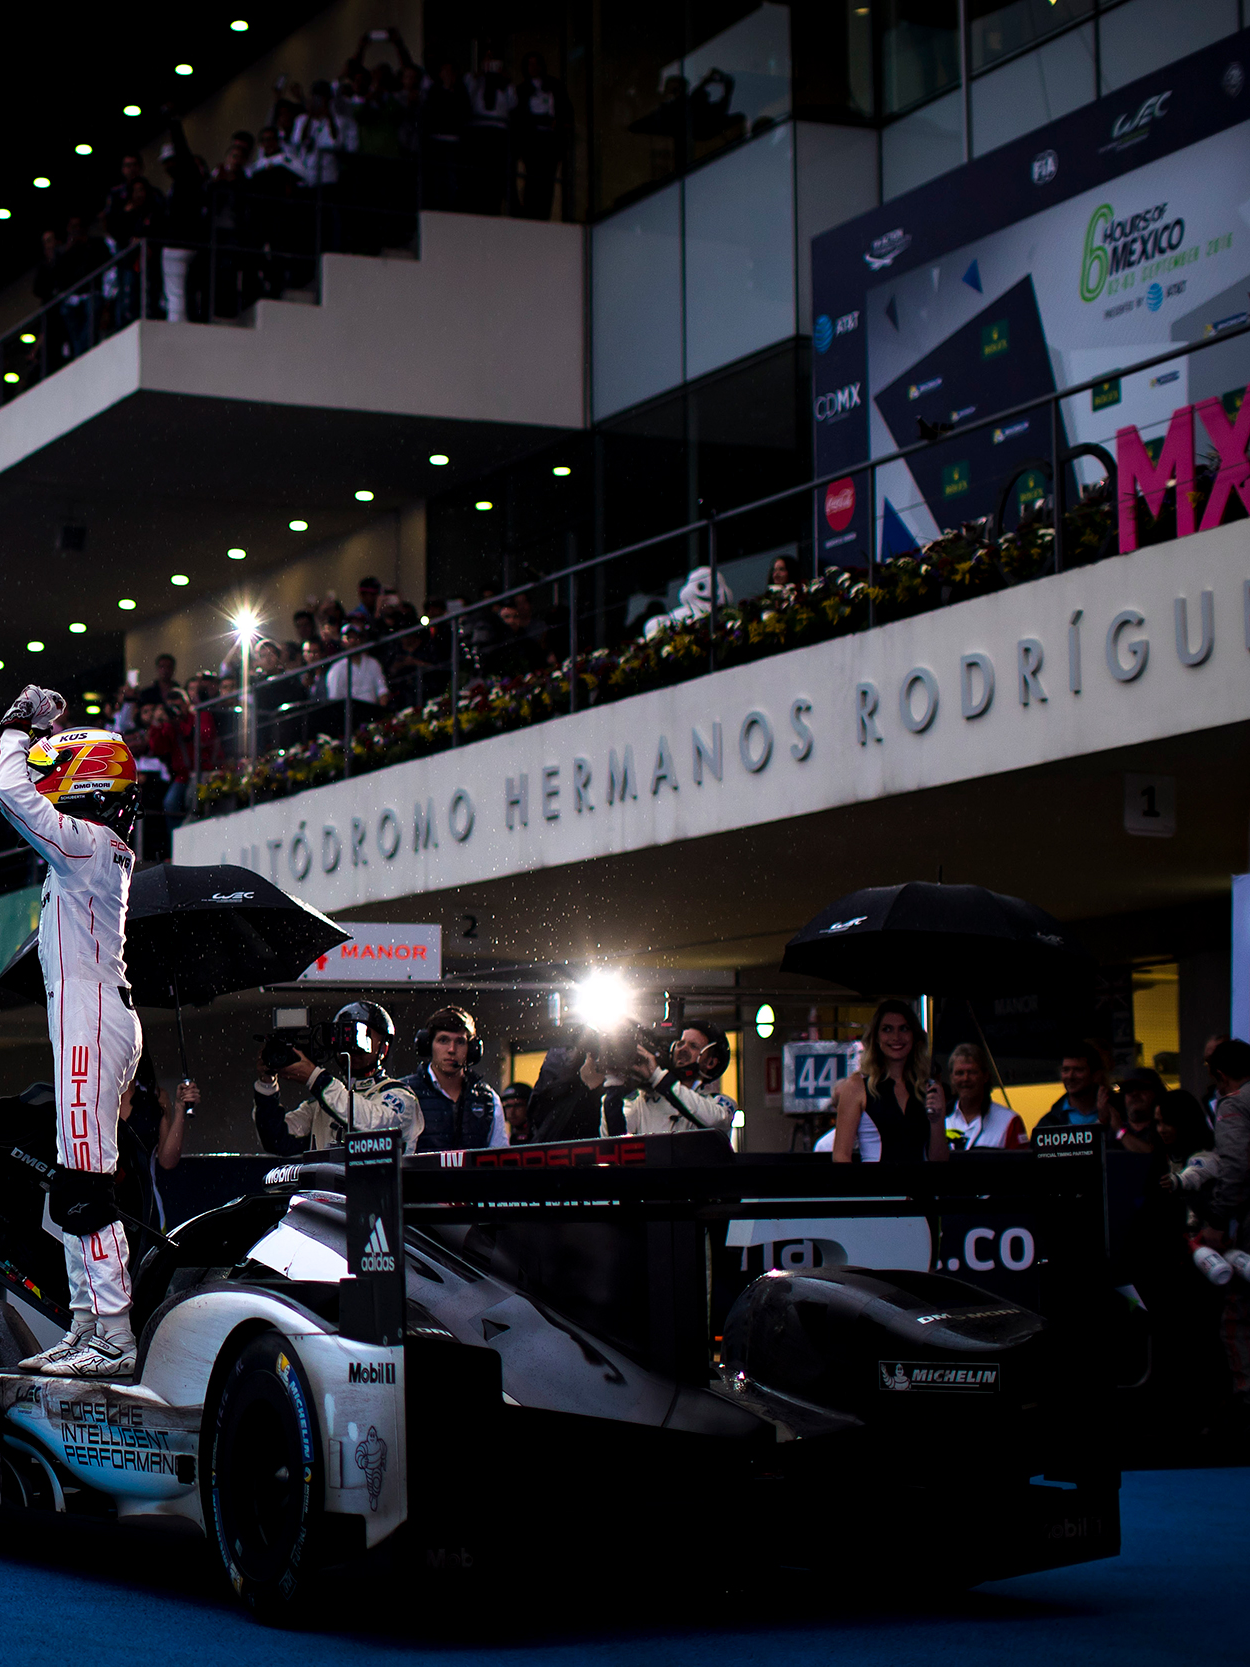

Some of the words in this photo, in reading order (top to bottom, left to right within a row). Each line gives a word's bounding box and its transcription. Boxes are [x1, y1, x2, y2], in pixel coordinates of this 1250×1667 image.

[1102, 206, 1155, 245] HOURS
[1078, 203, 1114, 303] 6
[1109, 217, 1185, 277] MEXICO
[835, 310, 860, 336] AT&T
[813, 381, 862, 422] CDMX
[505, 698, 813, 830] HERMANOS
[856, 580, 1250, 746] RODRÍGU
[1140, 785, 1161, 818] 1
[212, 891, 255, 900] WEC
[462, 915, 478, 938] 2
[341, 944, 428, 961] MANOR
[798, 1056, 838, 1096] 44
[348, 1137, 393, 1154] CHOPARD
[1036, 1131, 1094, 1147] CHOPARD
[9, 1147, 49, 1173] DMG
[361, 1252, 396, 1272] adidas
[349, 1362, 384, 1384] Mobil
[910, 1368, 996, 1384] MICHELIN
[15, 1384, 42, 1404] WEC
[59, 1400, 143, 1426] PORSCHE
[289, 1380, 312, 1459] MICHELIN
[61, 1422, 170, 1451] INTELLIGENT
[63, 1444, 179, 1476] PERFORMAN
[425, 1546, 475, 1571] Mob
